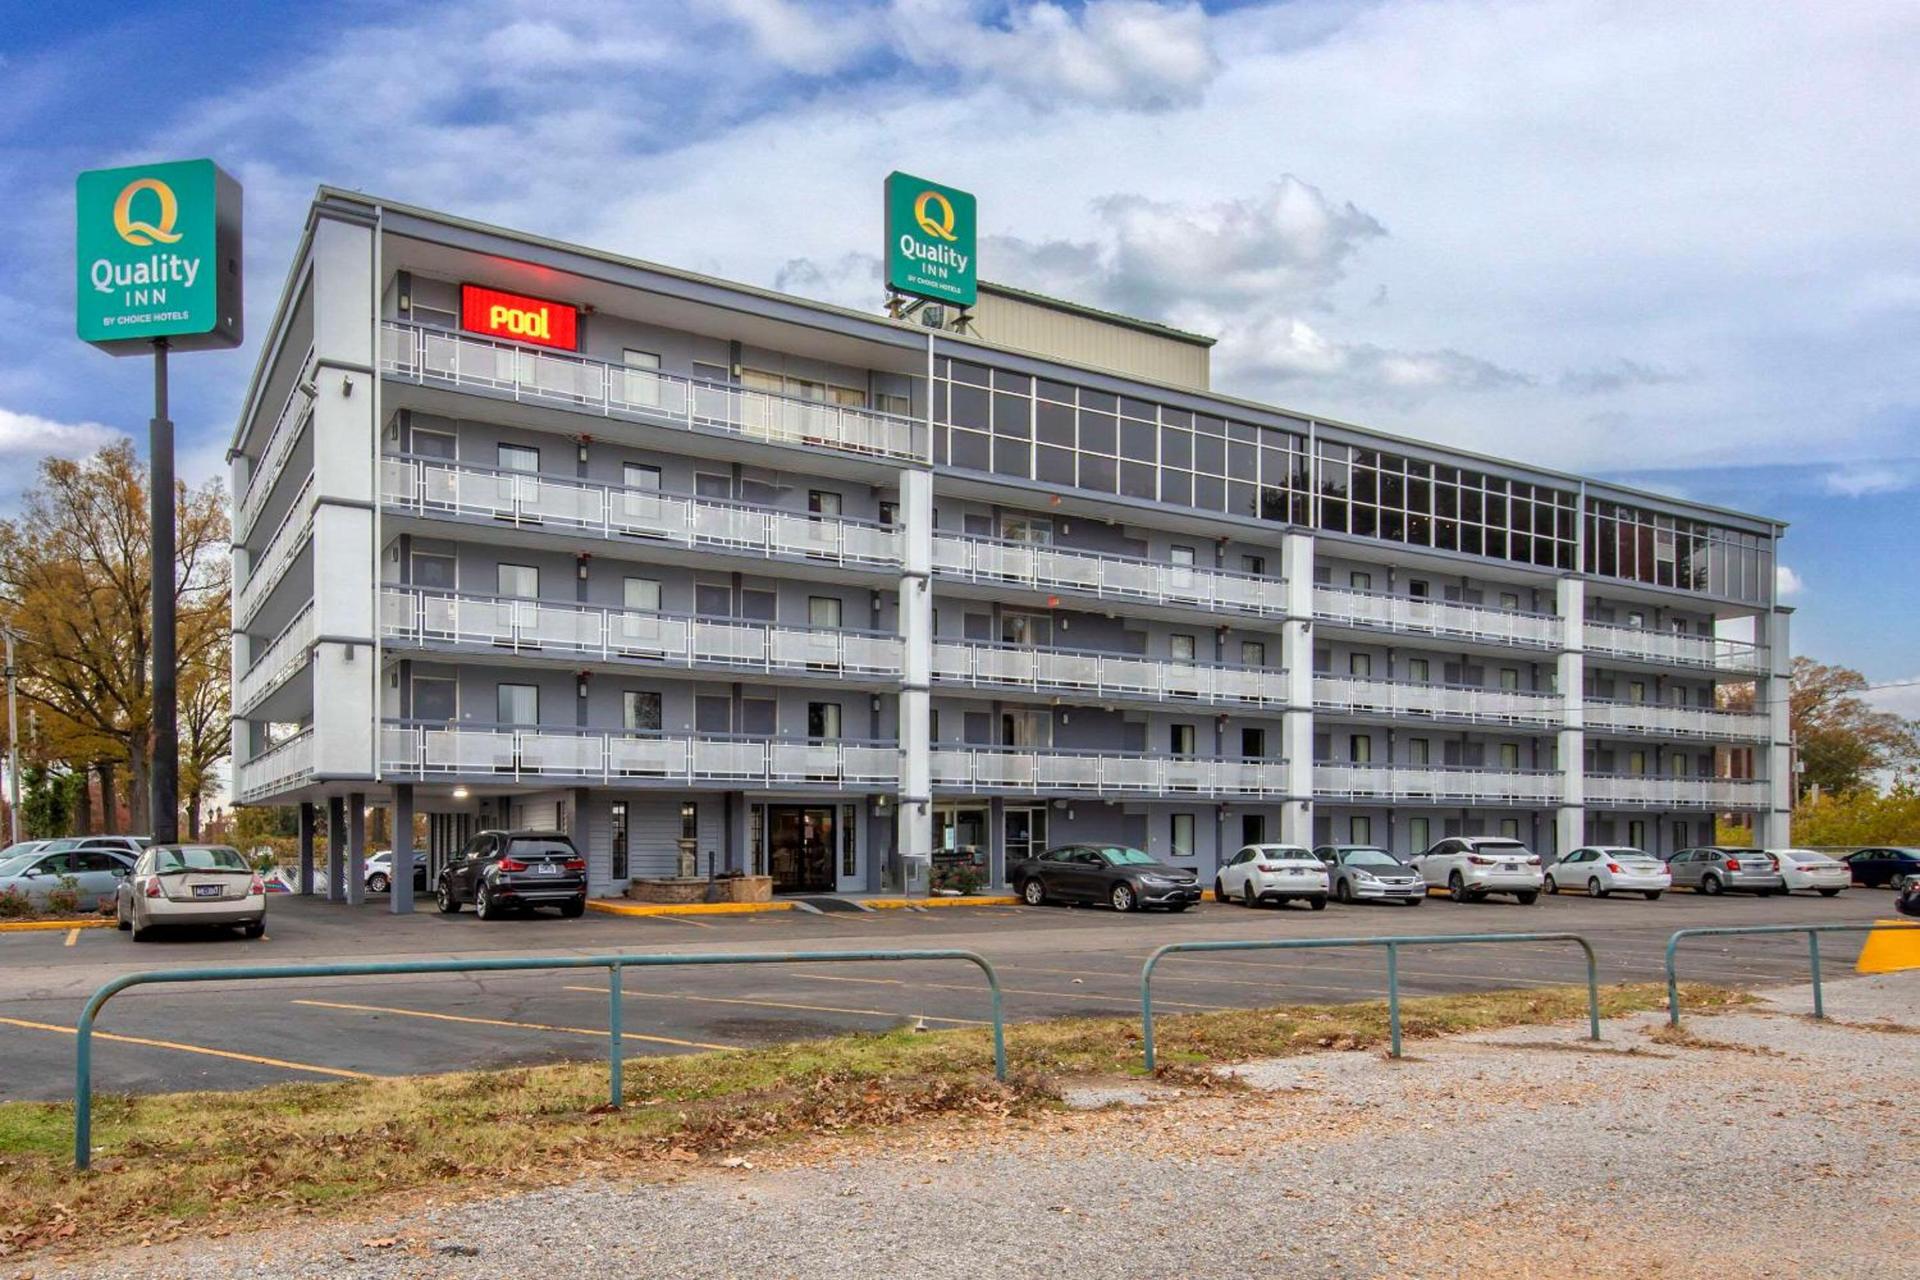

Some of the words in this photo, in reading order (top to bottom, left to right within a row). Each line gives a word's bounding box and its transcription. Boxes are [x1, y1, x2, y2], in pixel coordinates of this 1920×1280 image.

[113, 177, 184, 247] Q
[914, 190, 959, 242] Q
[900, 233, 968, 275] Quality
[91, 253, 201, 294] Quality
[907, 274, 917, 283] BY
[916, 277, 939, 289] CHOICE
[939, 283, 962, 294] HOTELS
[921, 262, 948, 279] INN
[125, 287, 167, 307] INN
[103, 316, 116, 327] BY
[116, 312, 152, 326] CHOICE
[152, 309, 190, 323] HOTELS
